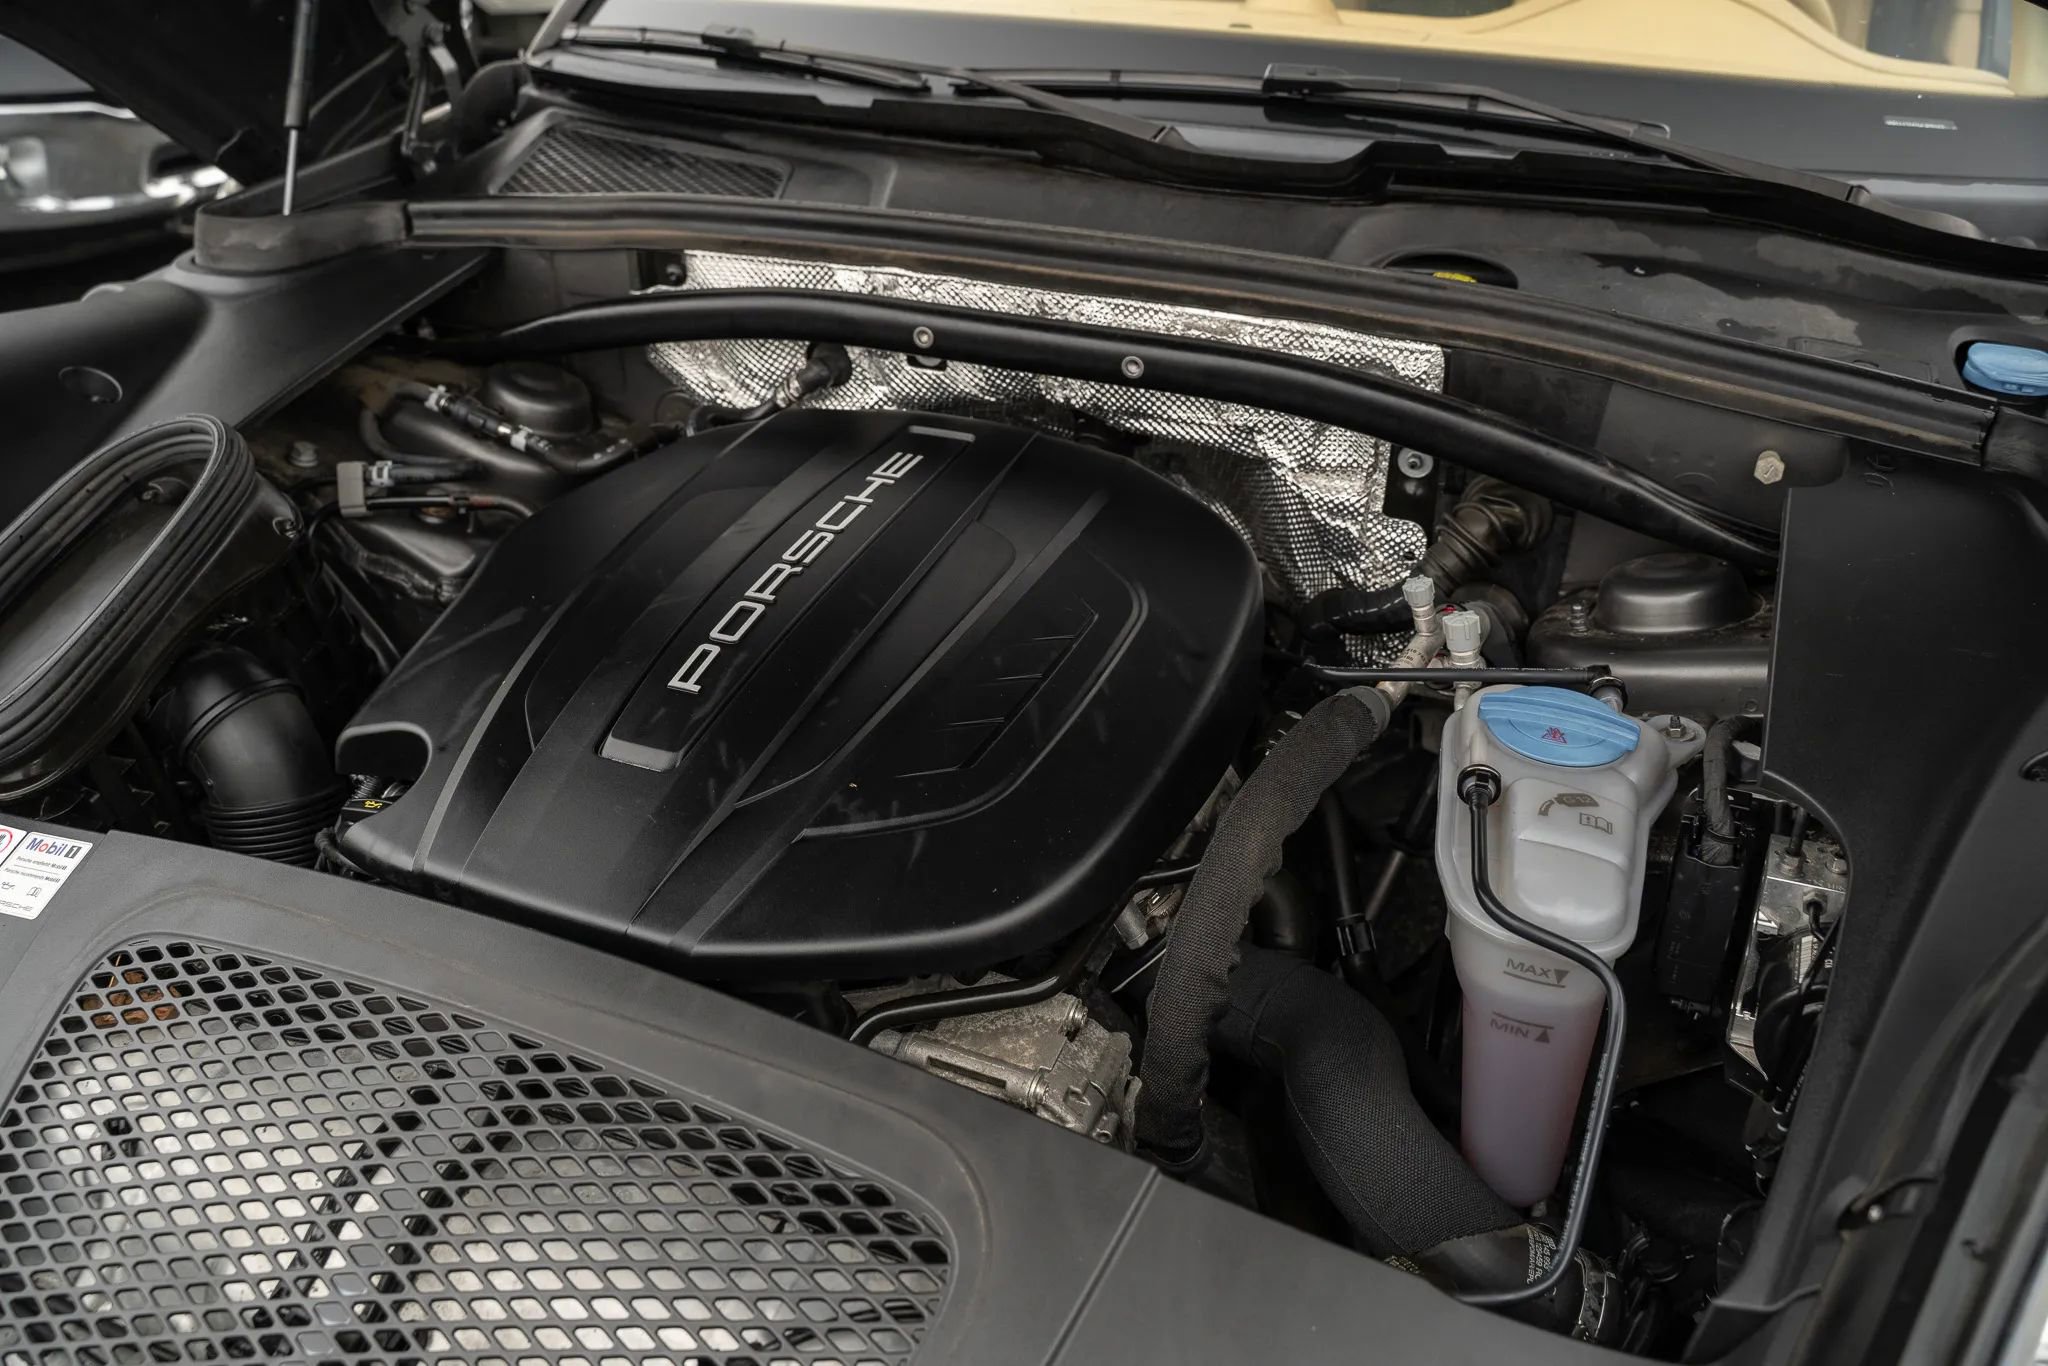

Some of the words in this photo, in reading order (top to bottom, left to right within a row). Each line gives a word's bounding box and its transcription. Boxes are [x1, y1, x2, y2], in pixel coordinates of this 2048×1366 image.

[667, 452, 924, 693] PORSCHE
[25, 837, 69, 857] Mobil
[64, 845, 83, 859] 1
[1506, 958, 1552, 979] MAX
[1490, 1018, 1530, 1039] MIN
